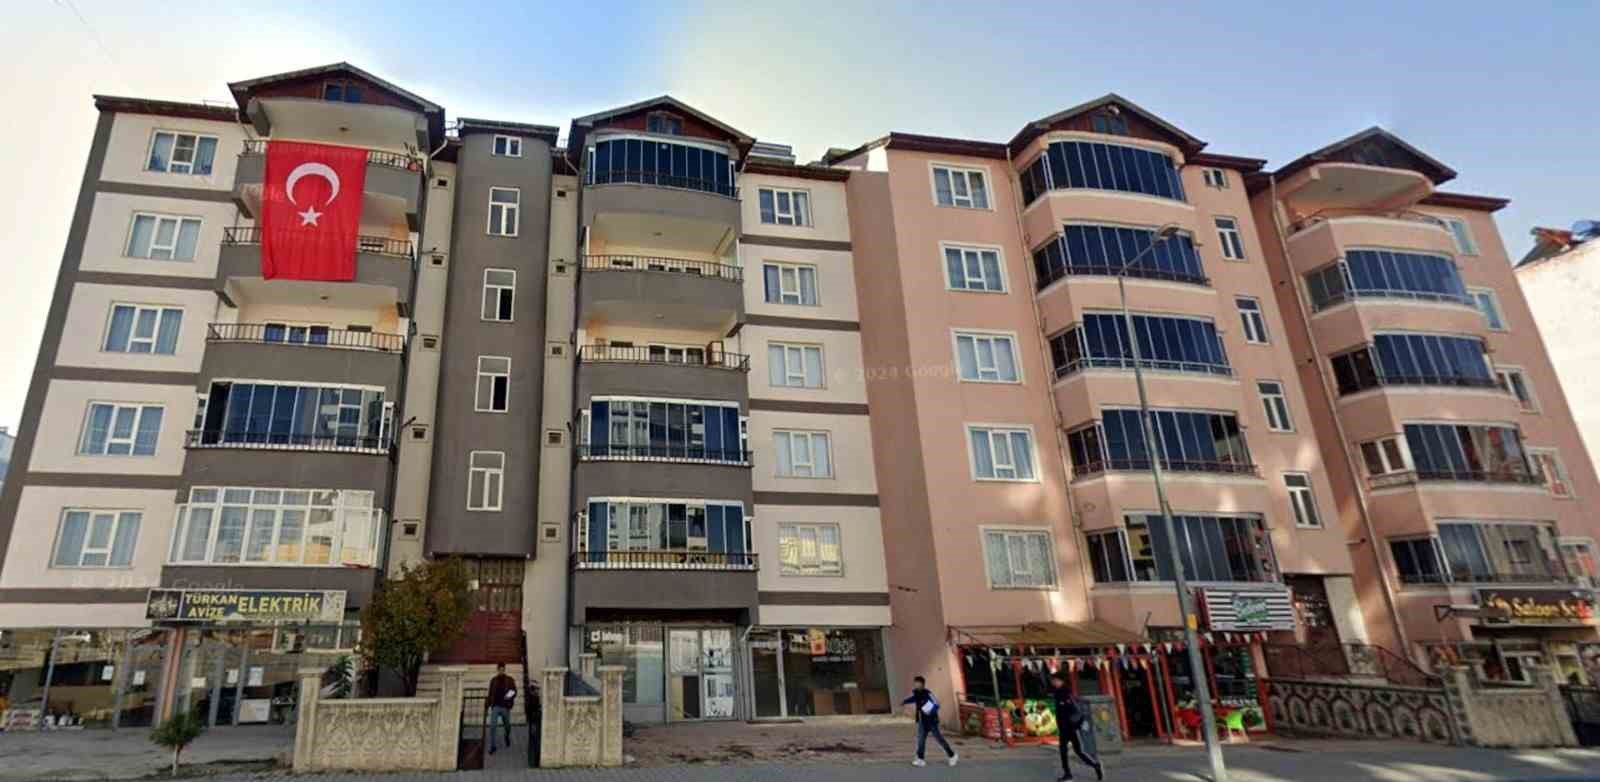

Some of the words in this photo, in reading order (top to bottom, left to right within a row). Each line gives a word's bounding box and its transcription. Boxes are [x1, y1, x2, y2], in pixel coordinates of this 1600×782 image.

[185, 592, 238, 606] TÜRKAN
[238, 593, 321, 614] ELEKTRİK
[187, 605, 225, 618] AVİZE
